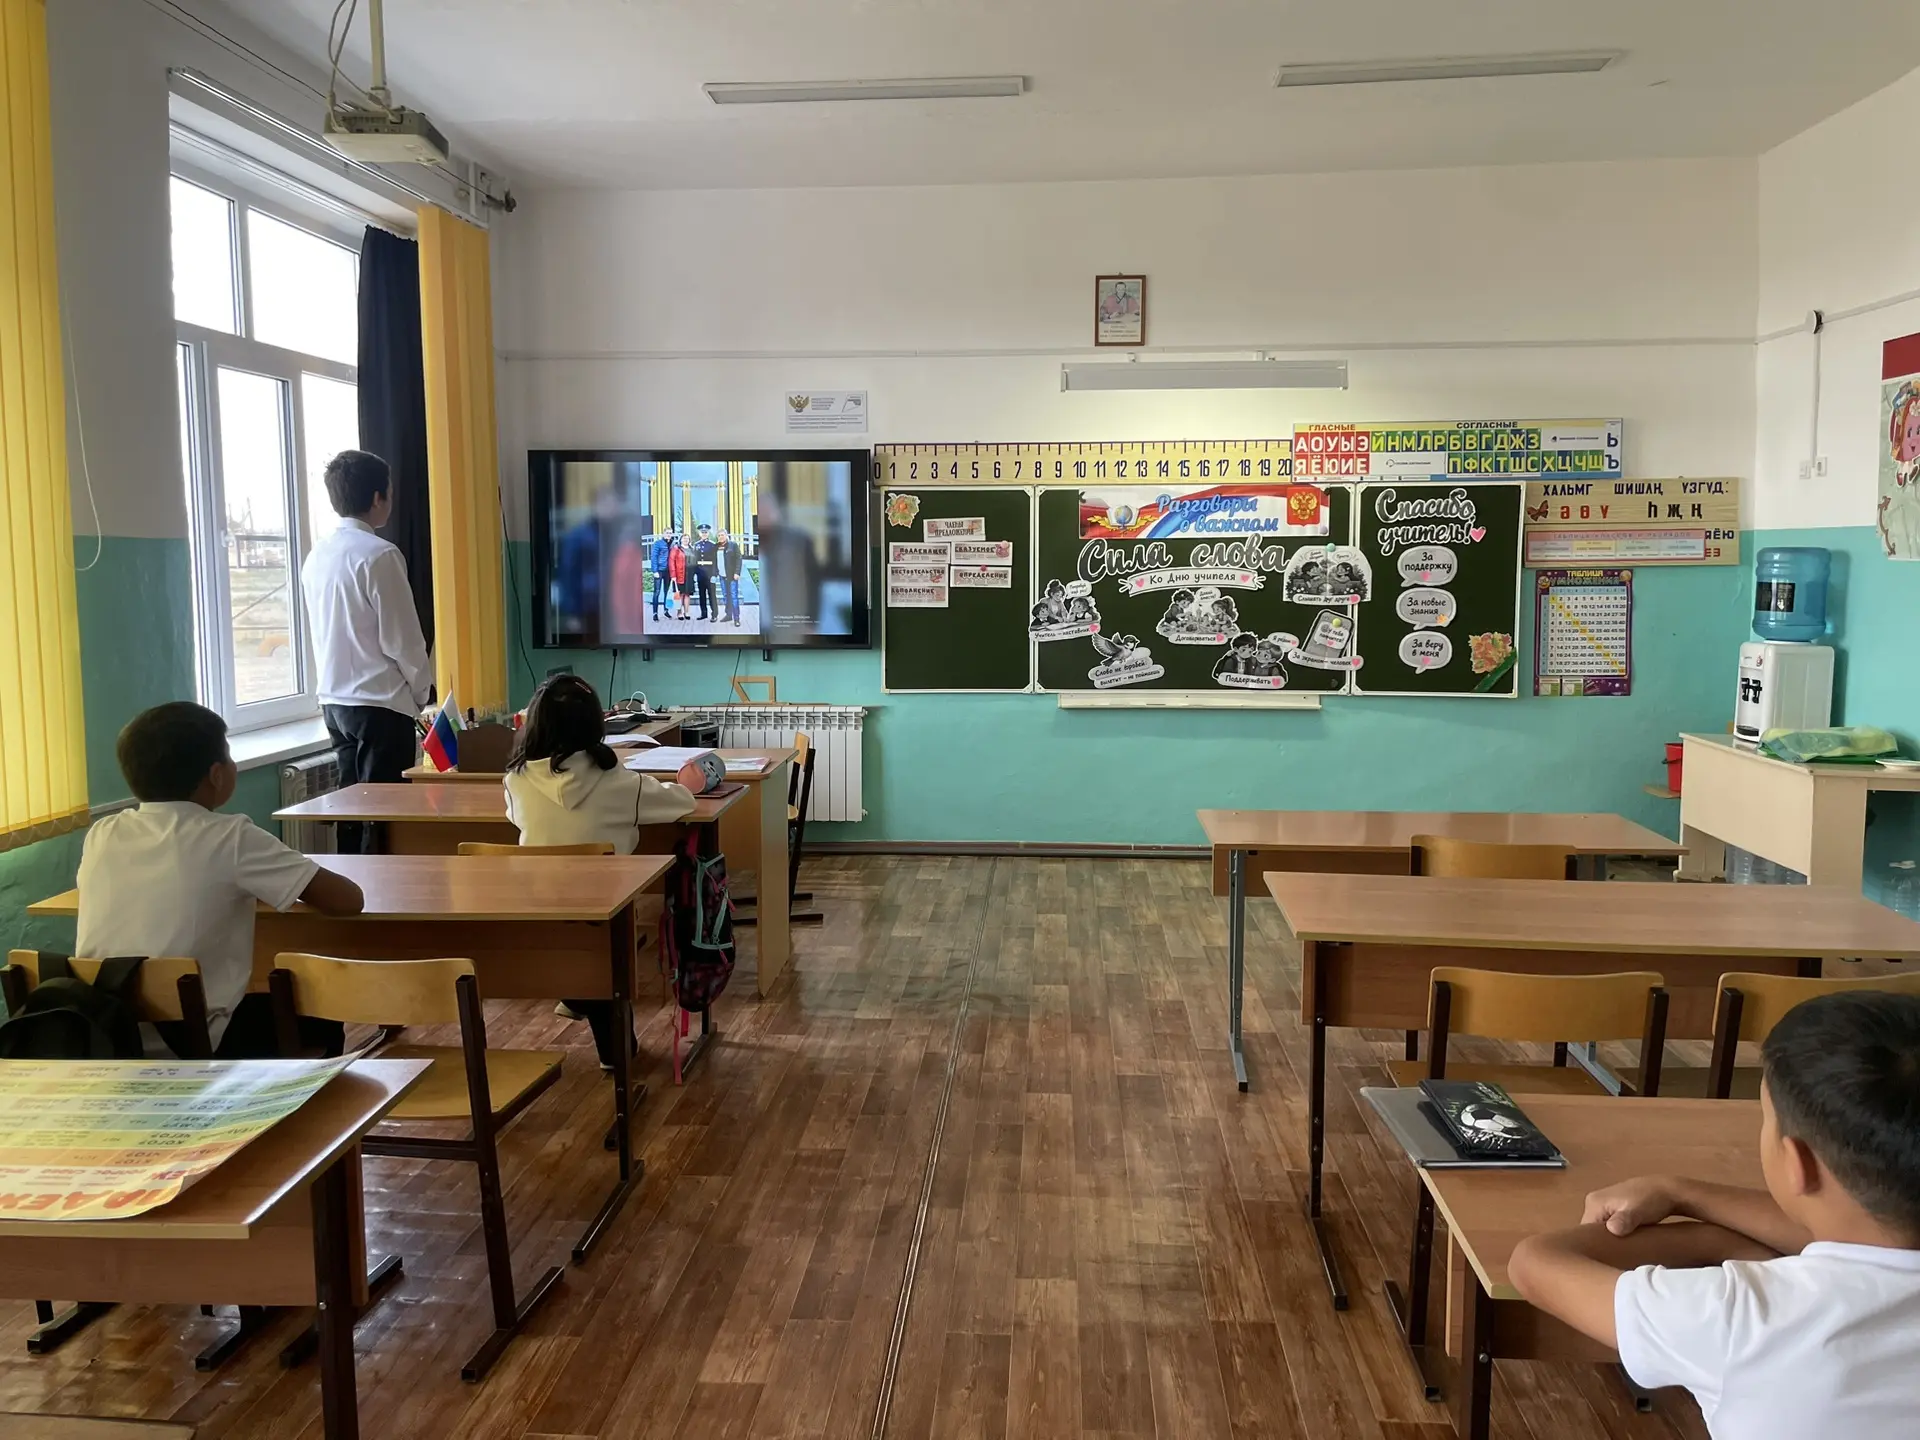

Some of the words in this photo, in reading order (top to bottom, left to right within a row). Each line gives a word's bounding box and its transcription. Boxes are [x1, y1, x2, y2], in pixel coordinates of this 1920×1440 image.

[1456, 421, 1518, 429] СОГЛАСНЫЕ
[874, 463, 881, 478] 0
[889, 462, 896, 478] 1
[910, 462, 917, 479] 2
[931, 462, 938, 479] 3
[951, 462, 958, 478] 4
[972, 462, 979, 478] 5
[994, 462, 1001, 478] 6
[1014, 462, 1022, 478] 7
[1035, 461, 1042, 478] 8
[1055, 461, 1062, 478] 9
[1073, 461, 1086, 478] 10
[1094, 460, 1106, 477] 11
[1114, 460, 1127, 477] 12
[1135, 460, 1147, 477] 13
[1156, 460, 1169, 477] 14
[1177, 460, 1190, 477] 15
[1197, 459, 1210, 476] 16
[1216, 459, 1229, 476] 17
[1238, 459, 1251, 476] 18
[1258, 459, 1270, 476] 19
[1278, 458, 1291, 476] 20
[1156, 493, 1259, 517] Разговоры
[1180, 519, 1191, 532] о
[1195, 515, 1279, 532] важном
[1378, 522, 1473, 556] учитель!
[1078, 538, 1172, 583] Сила
[1190, 533, 1289, 571] слова
[1422, 552, 1433, 561] За
[1405, 563, 1452, 573] поддержку
[1149, 575, 1163, 584] Ко
[1167, 573, 1190, 583] Дню
[1407, 597, 1418, 606] За
[1412, 639, 1422, 648] За
[1425, 639, 1443, 651] веру
[1095, 668, 1113, 677] Слово
[1225, 675, 1271, 686] Поддерживать
